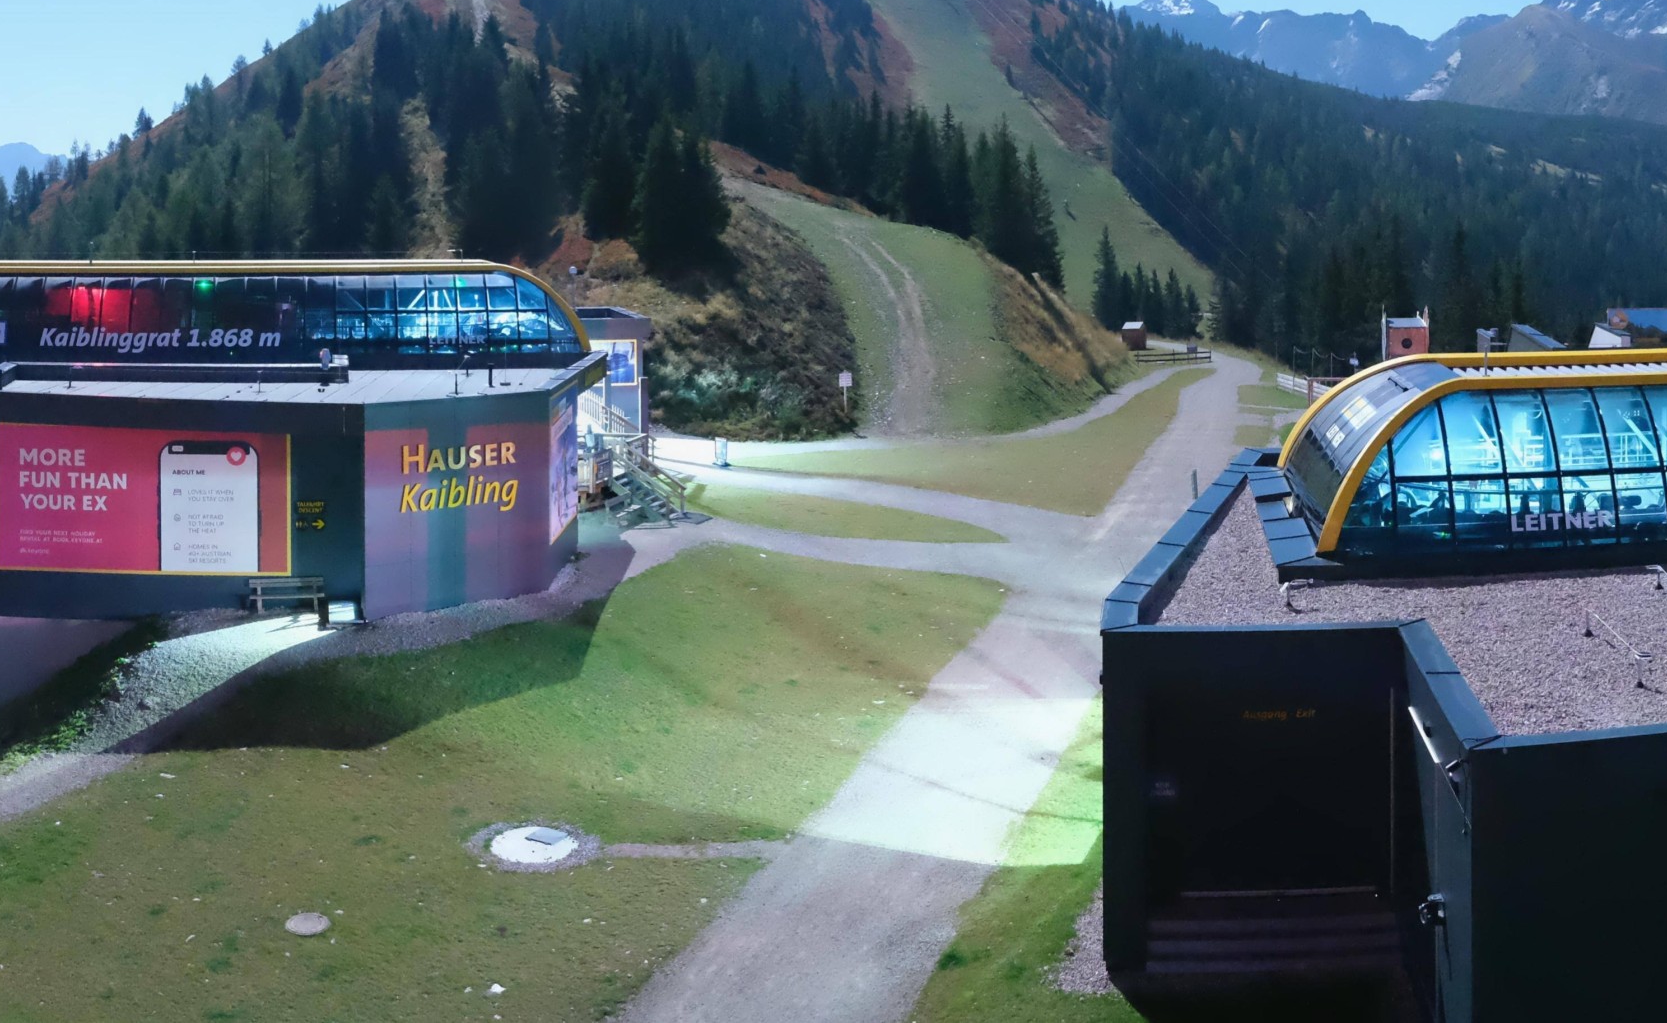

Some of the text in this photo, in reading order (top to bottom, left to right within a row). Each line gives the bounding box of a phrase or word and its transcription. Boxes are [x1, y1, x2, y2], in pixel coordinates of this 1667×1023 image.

[38, 326, 281, 353] Kaiblinggrat 1.868 m
[429, 334, 486, 345] LEITNER
[19, 448, 86, 467] MORE
[401, 441, 517, 475] HAUSER
[19, 471, 128, 490] FUN THAN
[20, 493, 108, 512] YOUR EX
[400, 475, 519, 513] Kaibling
[1511, 510, 1613, 532] LEITNER
